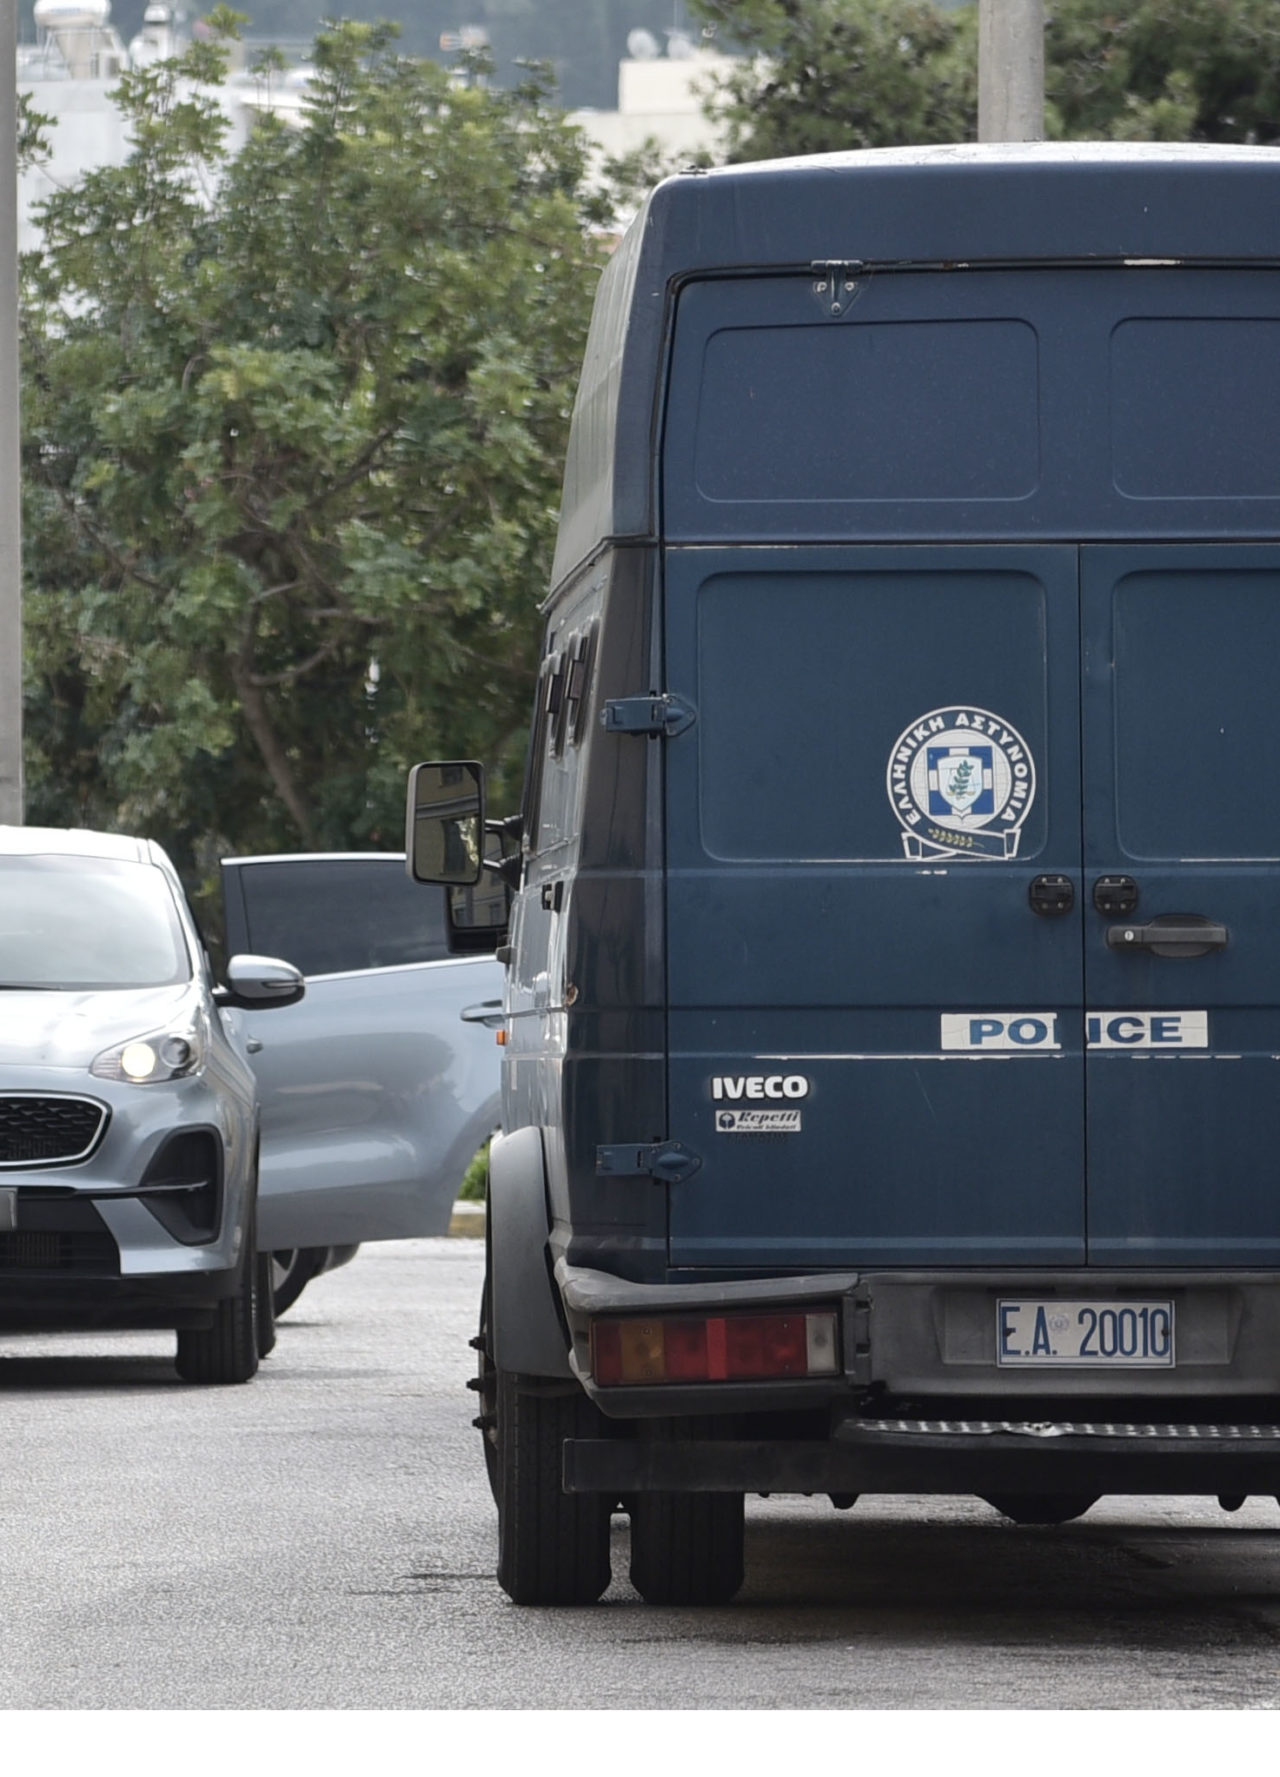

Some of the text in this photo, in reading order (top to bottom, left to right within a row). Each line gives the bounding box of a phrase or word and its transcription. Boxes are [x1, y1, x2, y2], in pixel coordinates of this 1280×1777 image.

[892, 712, 1028, 825] ΕΛΛΗΝΙΚΗ ΑΣΤΥΝΟΜΙΑ
[969, 1016, 1183, 1046] POICE
[712, 1075, 808, 1099] IVECO
[738, 1111, 799, 1124] Repetti
[1078, 1307, 1169, 1357] 20010
